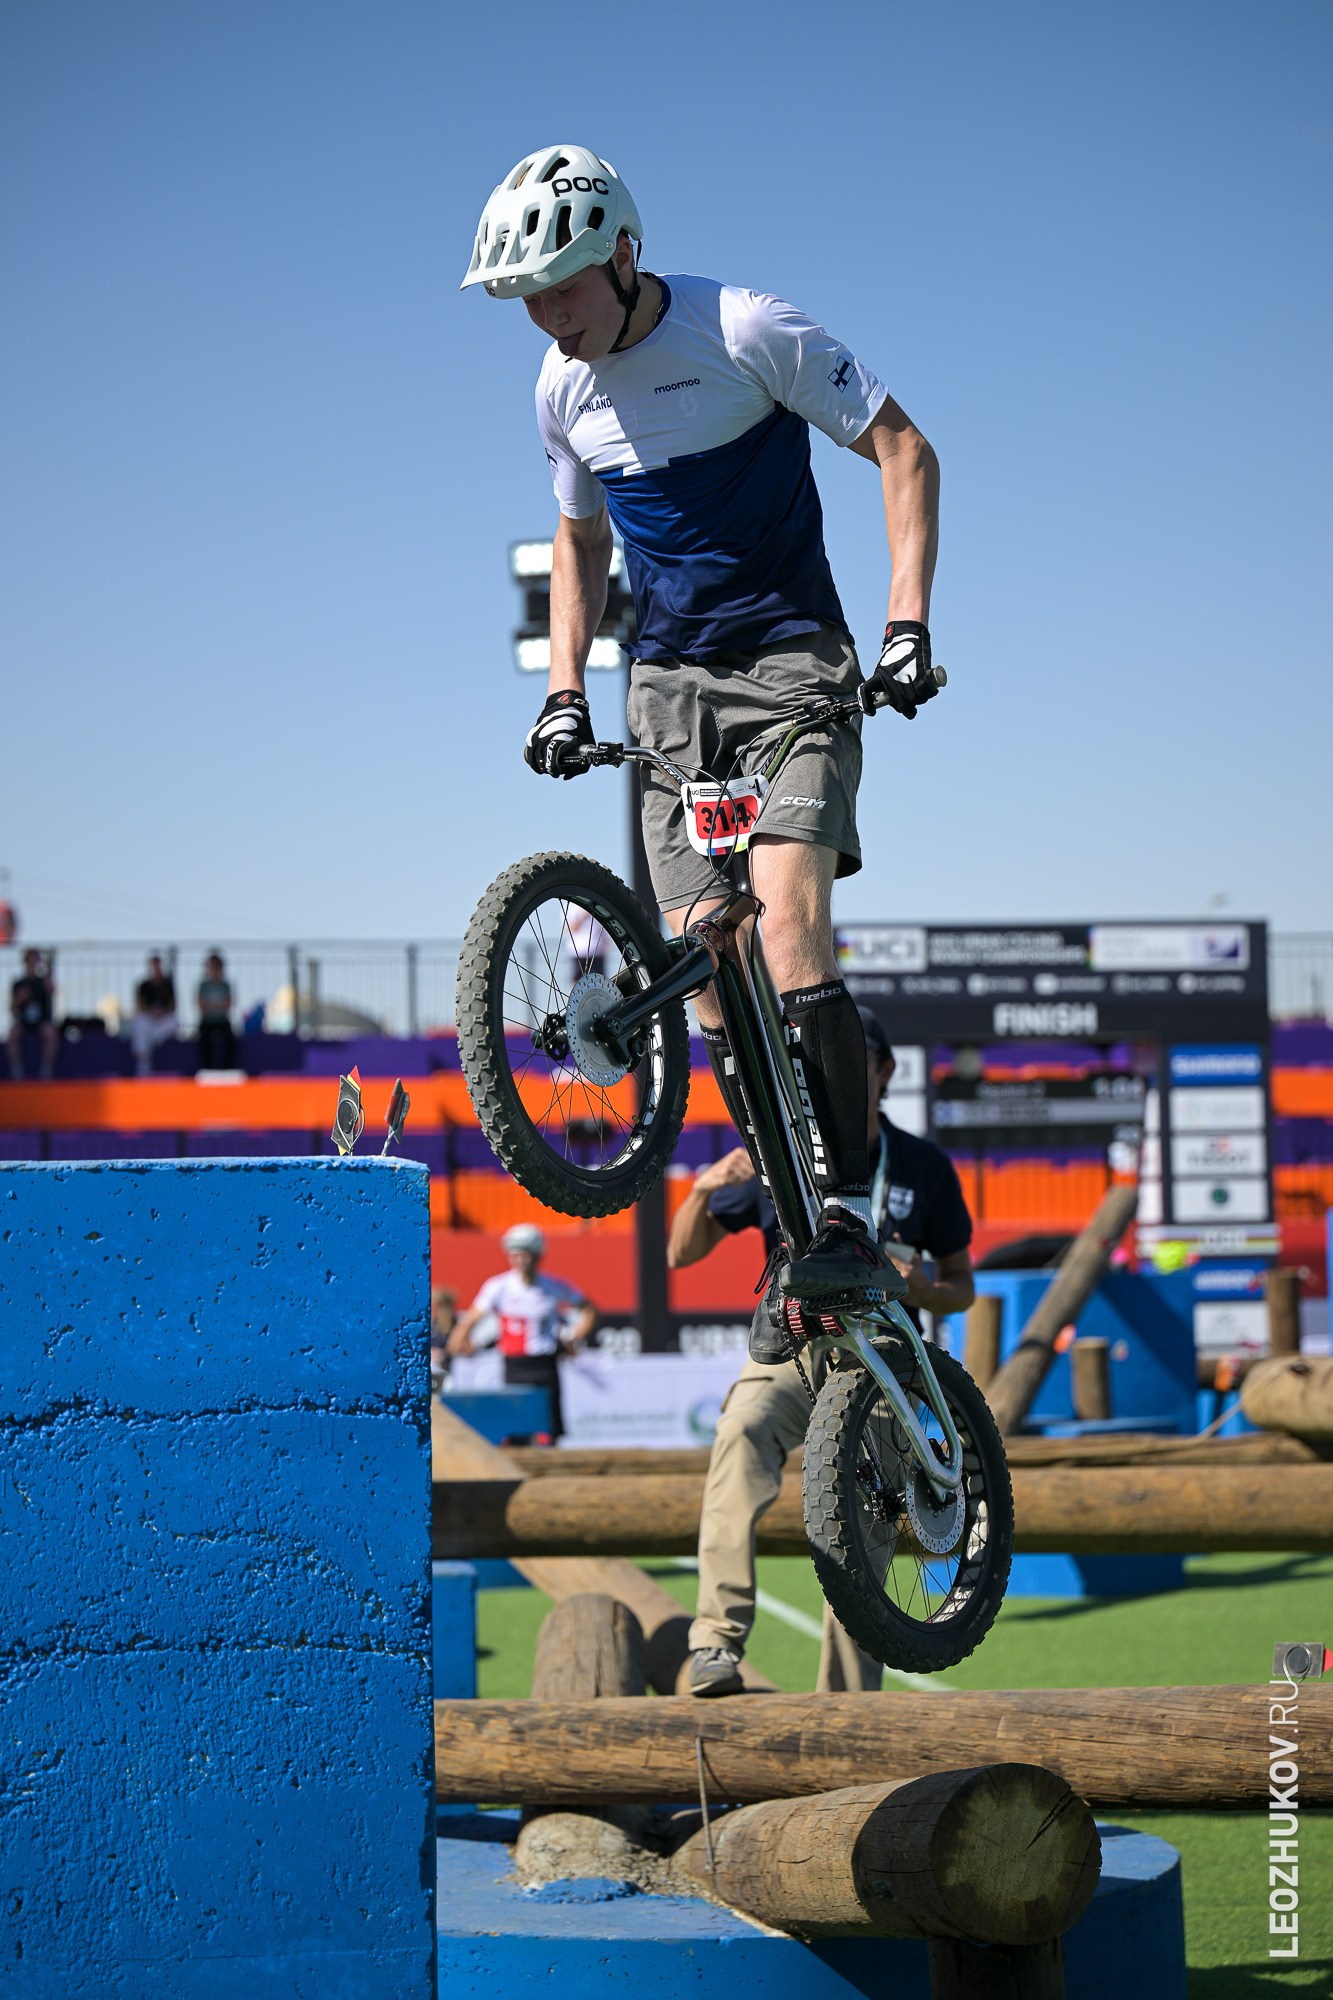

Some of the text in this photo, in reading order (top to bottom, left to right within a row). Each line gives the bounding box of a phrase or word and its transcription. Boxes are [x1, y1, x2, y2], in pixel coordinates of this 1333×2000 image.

[654, 378, 701, 394] moomoo
[578, 397, 612, 414] FINLAND
[779, 796, 827, 810] CCM
[701, 802, 751, 834] 314
[795, 987, 842, 1004] hebo
[994, 1002, 1098, 1036] FINISH
